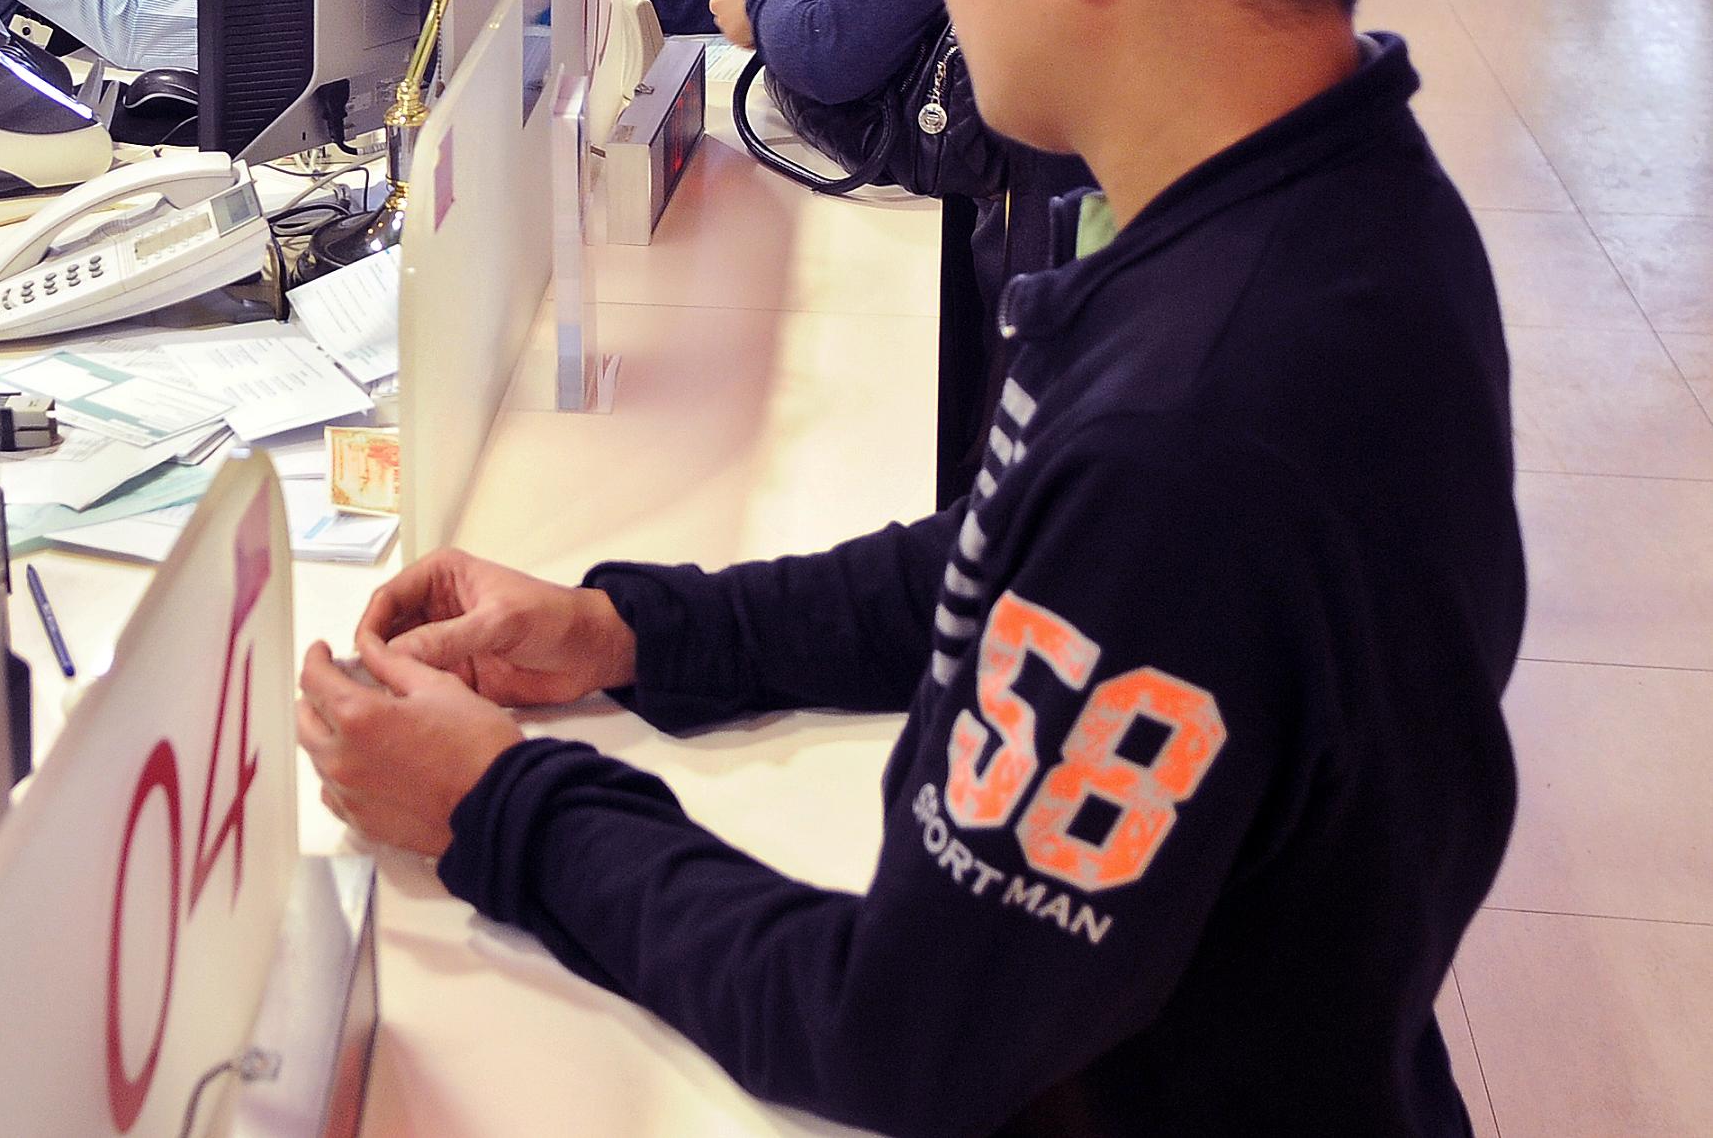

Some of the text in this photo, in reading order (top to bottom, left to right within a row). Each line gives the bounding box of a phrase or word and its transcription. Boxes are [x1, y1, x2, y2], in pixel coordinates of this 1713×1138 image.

[105, 607, 260, 1135] 04
[945, 589, 1227, 892] 58
[1001, 875, 1114, 944] MAN
